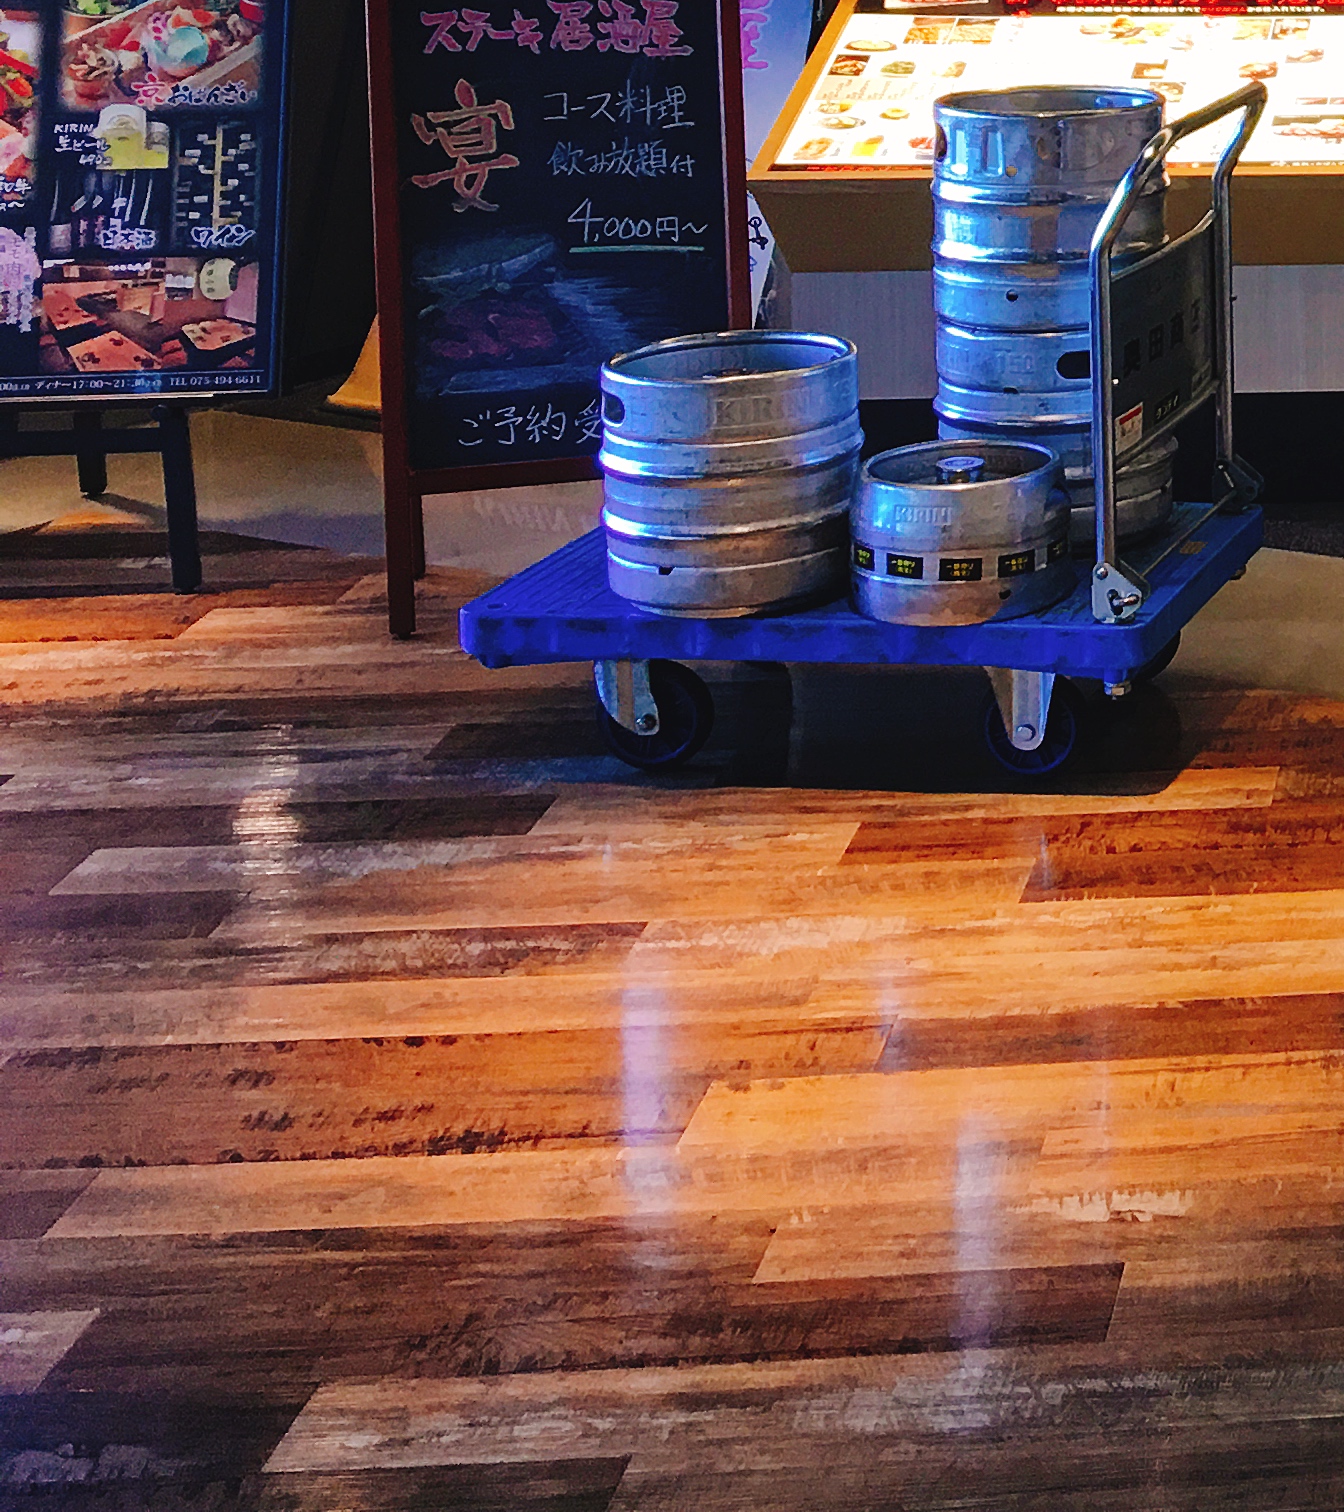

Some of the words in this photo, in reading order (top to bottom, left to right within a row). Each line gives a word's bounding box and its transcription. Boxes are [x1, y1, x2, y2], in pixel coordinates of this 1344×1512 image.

[542, 79, 696, 128] コース料理
[53, 123, 94, 134] KIRIN
[410, 78, 521, 213] 宴
[547, 140, 696, 178] 飲み放題付
